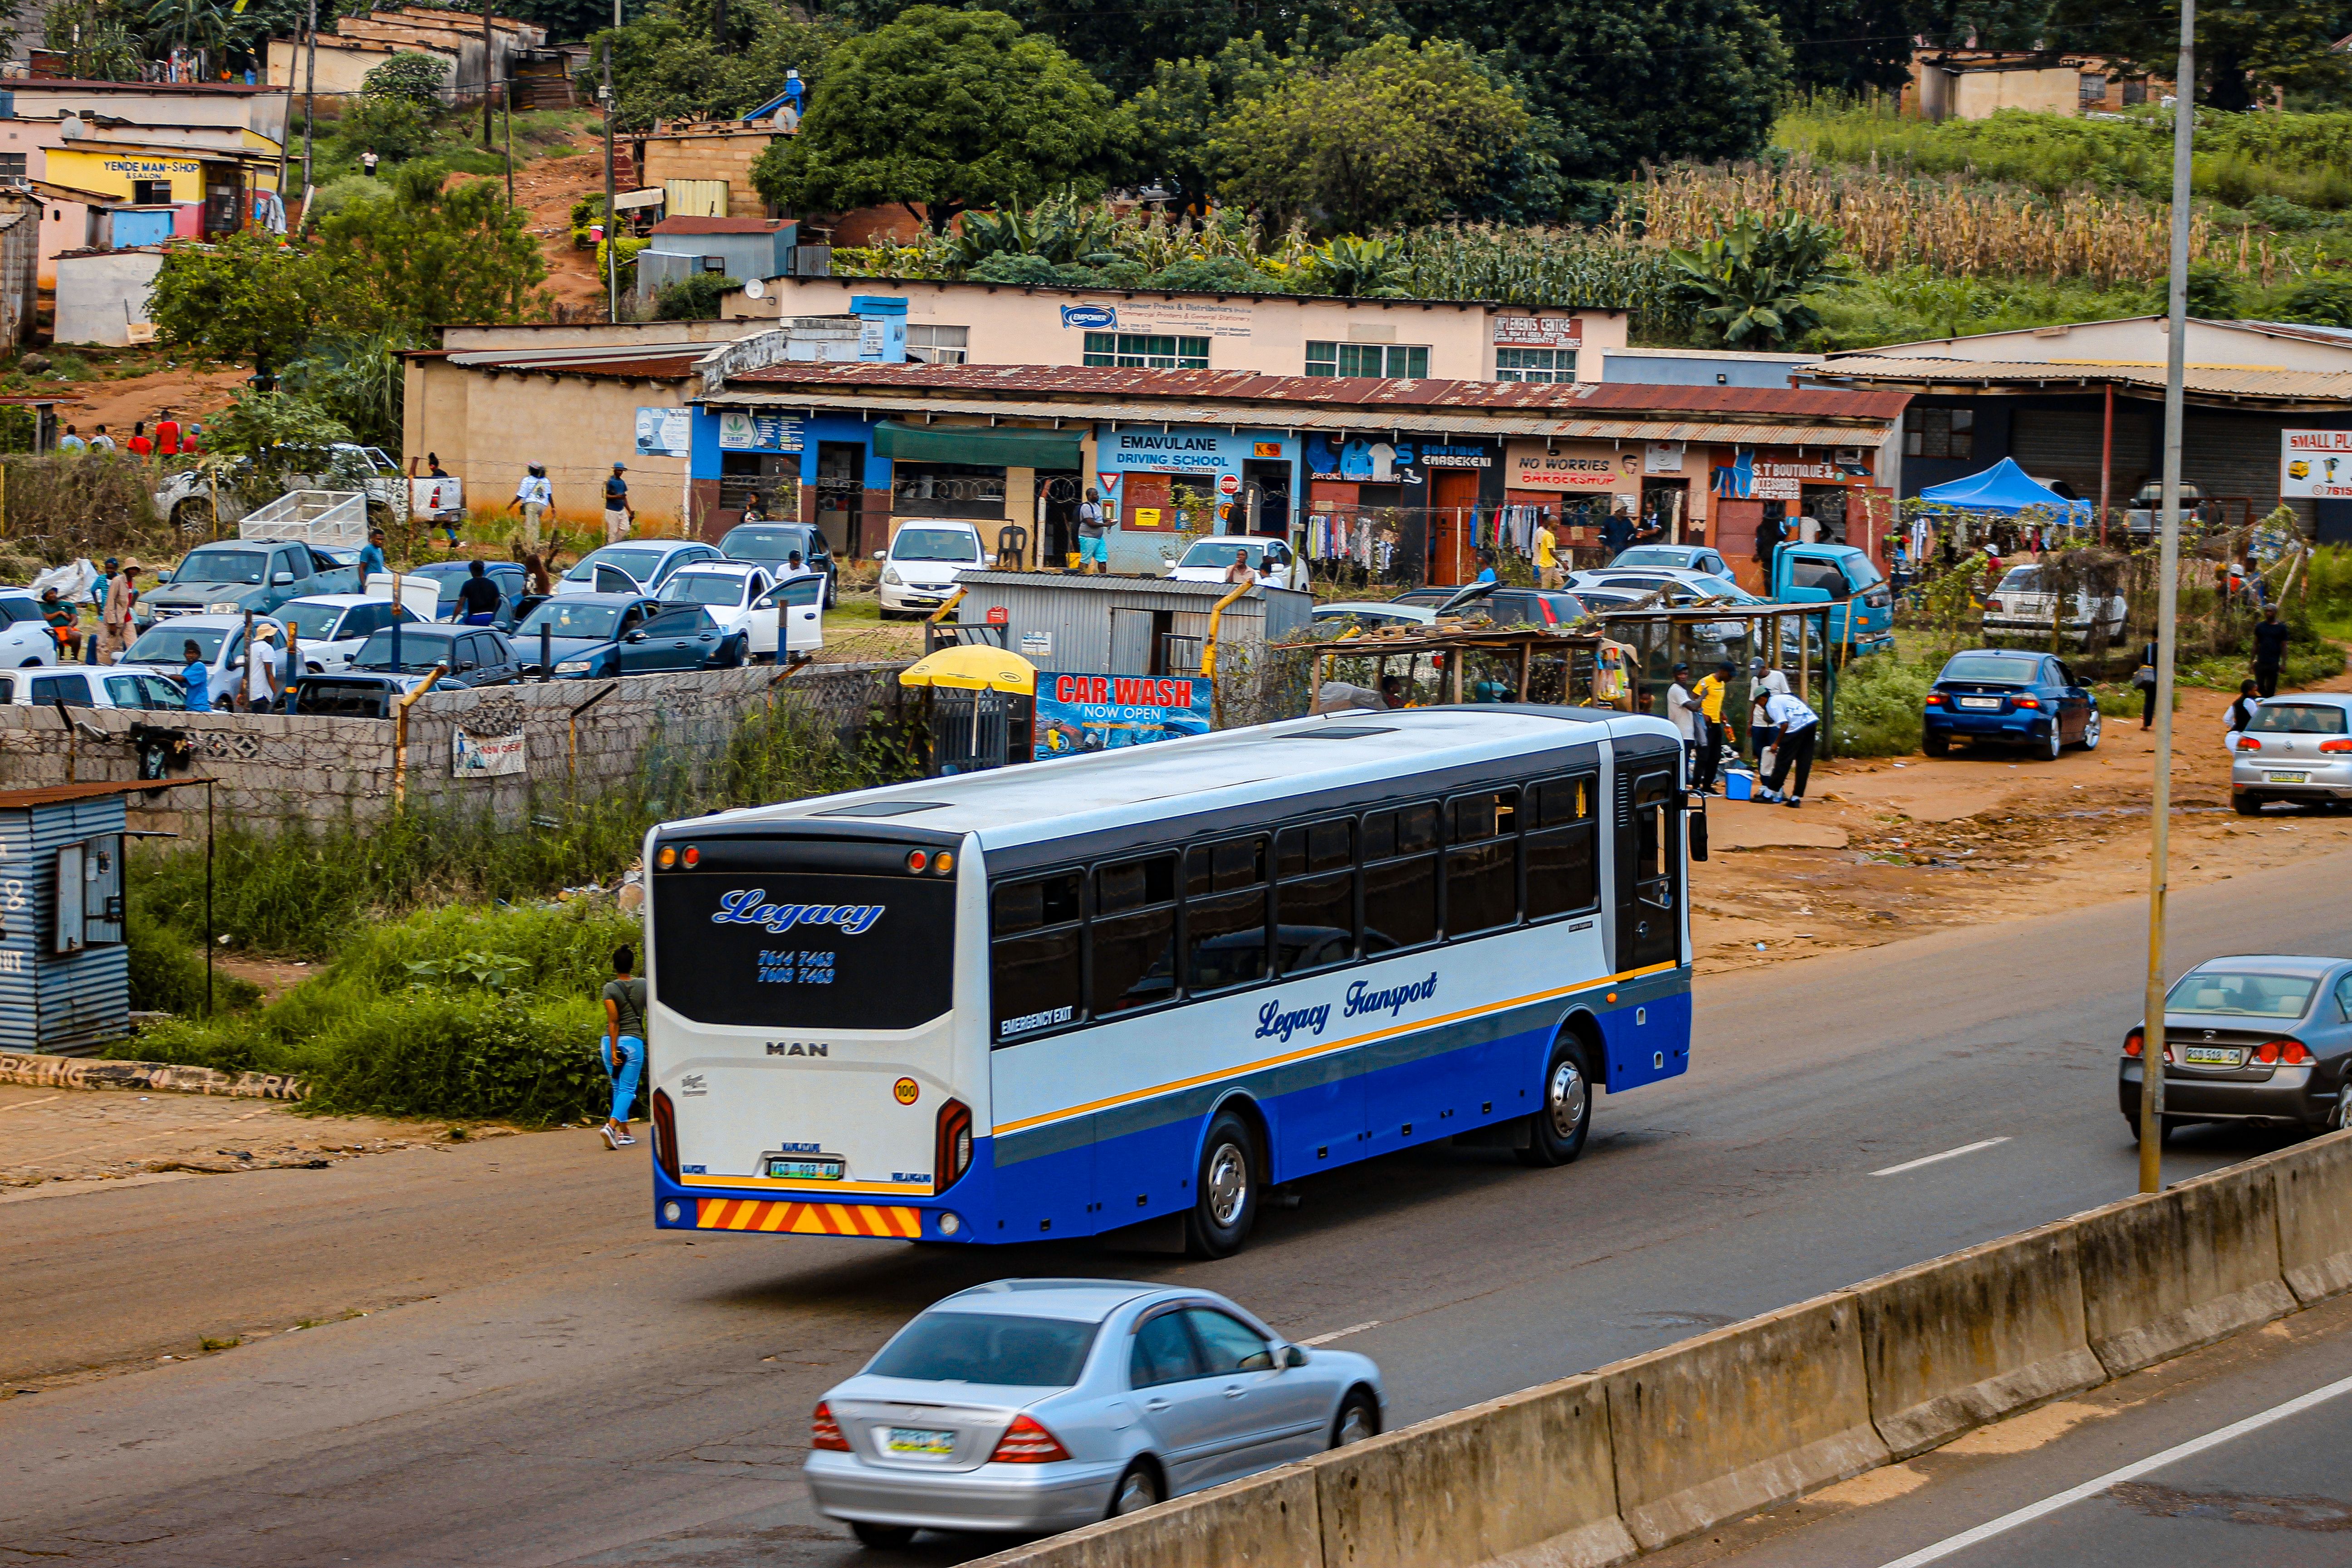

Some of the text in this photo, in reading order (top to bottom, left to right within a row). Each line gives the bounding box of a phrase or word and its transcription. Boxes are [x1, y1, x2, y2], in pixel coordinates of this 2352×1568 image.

[104, 162, 139, 172] YENDE
[1117, 301, 1152, 309] Empower
[1186, 304, 1232, 313] Distributors
[1073, 314, 1107, 322] EMPOWER
[1121, 436, 1216, 451] EMAVULANE
[2290, 434, 2330, 448] SMALL
[1421, 445, 1484, 456] BOUTIQUE
[1117, 453, 1229, 467] DRIVING SCHOOL
[1421, 456, 1492, 467] EMASEKENI
[1519, 458, 1610, 471] NO WORRIES
[1522, 471, 1617, 485] BARBERSHOP
[1773, 464, 1824, 478] BOUTIQUE
[1758, 490, 1800, 499] REPAIRS
[1056, 675, 1192, 708] CAR WASH
[1084, 706, 1161, 720] NOW OPEN
[711, 888, 885, 934] Legacy
[757, 950, 836, 967] 7614 7463
[798, 968, 836, 984] 7463
[1254, 970, 1438, 1043] Legacy Transport
[1001, 1005, 1073, 1035] EMERGENCY EXIT
[766, 1042, 828, 1056] MAN
[897, 1084, 916, 1098] 100
